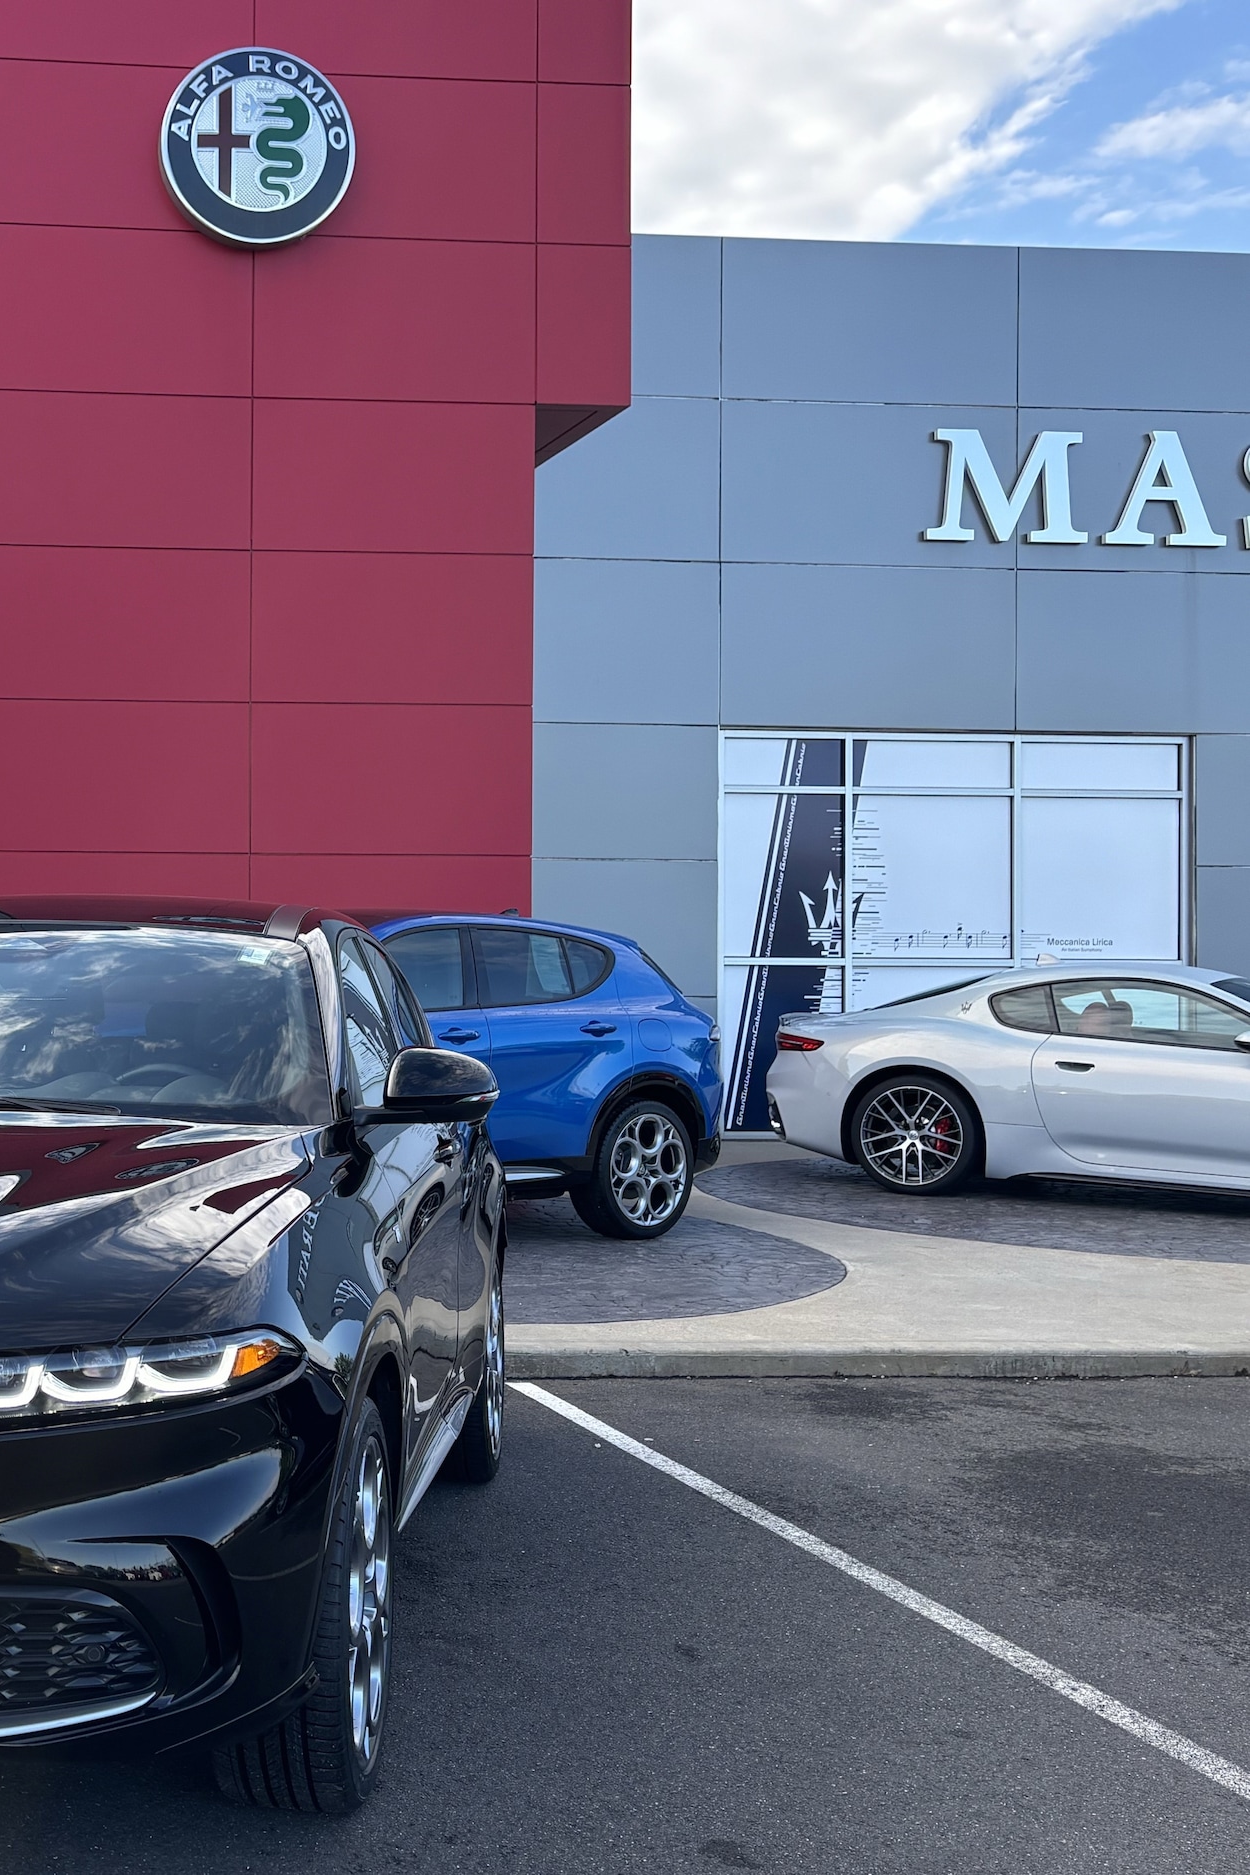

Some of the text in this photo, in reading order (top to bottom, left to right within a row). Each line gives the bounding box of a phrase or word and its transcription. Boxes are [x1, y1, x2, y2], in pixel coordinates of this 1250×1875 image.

[170, 54, 348, 151] ALFA ROMEO
[923, 427, 1250, 550] MA
[1092, 938, 1113, 946] Lirica
